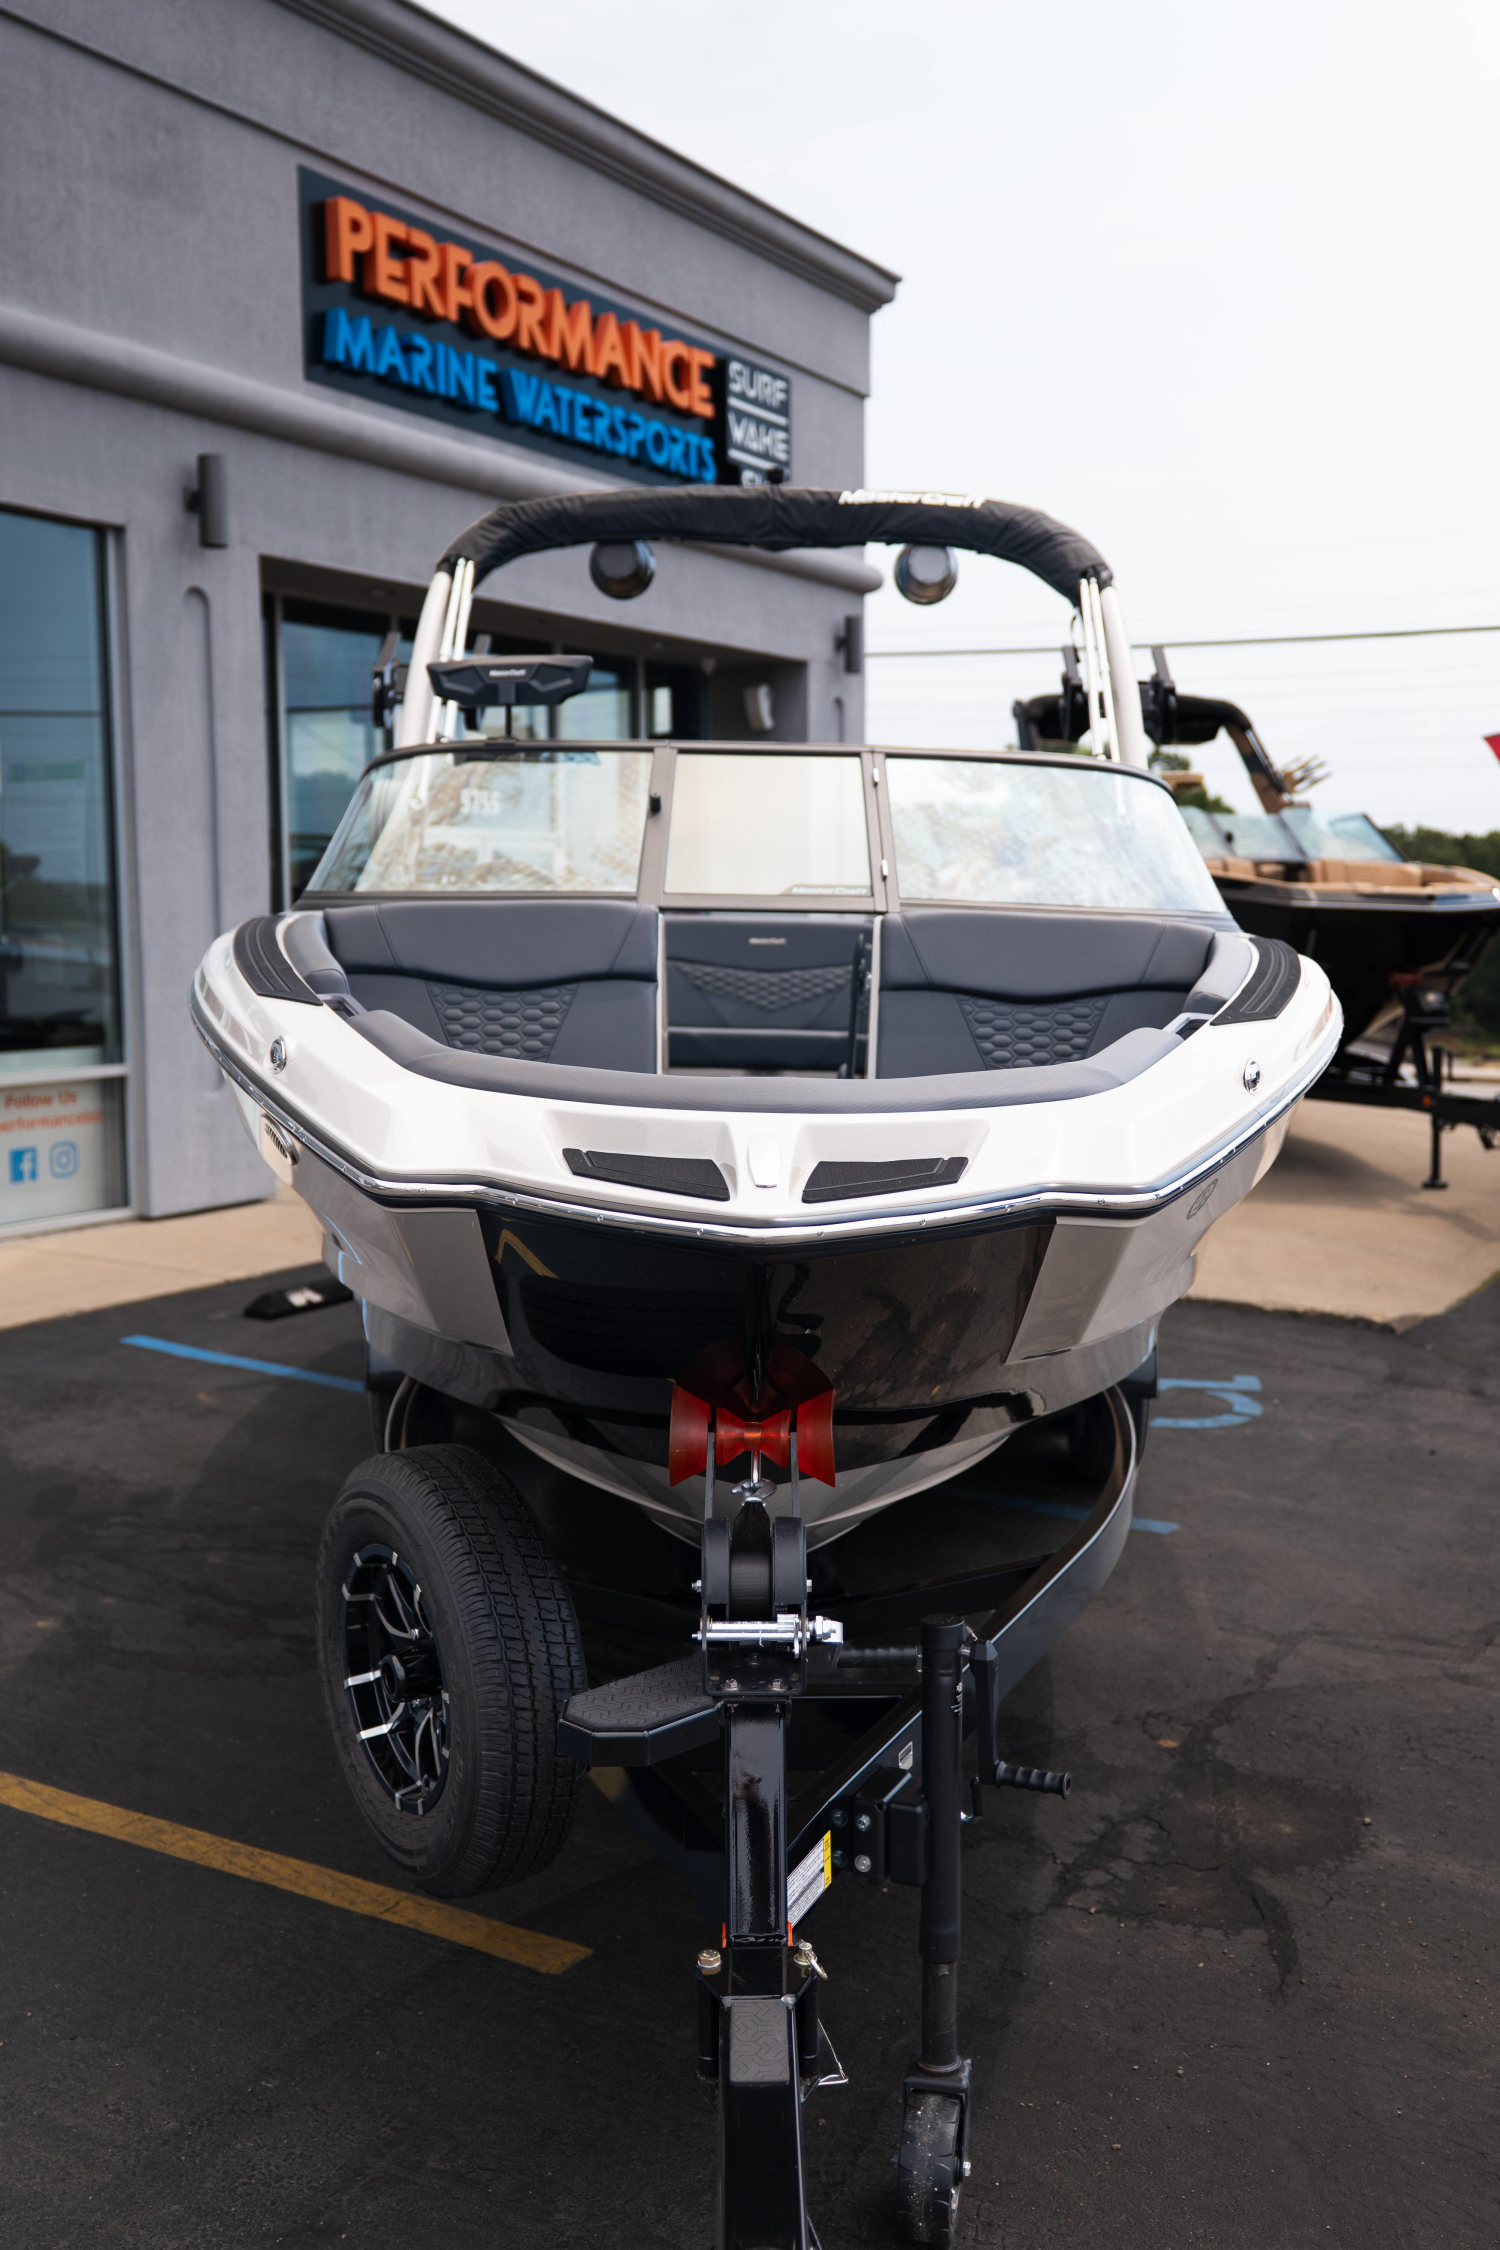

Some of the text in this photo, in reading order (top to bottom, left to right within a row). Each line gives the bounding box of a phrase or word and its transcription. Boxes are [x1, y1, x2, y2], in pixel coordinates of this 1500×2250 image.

[325, 195, 716, 418] PERFORMANCE
[323, 307, 716, 483] MARINE WATERSPORTS
[729, 360, 788, 409] SURF
[728, 411, 789, 462] WAKE
[4, 1093, 53, 1110] Follow
